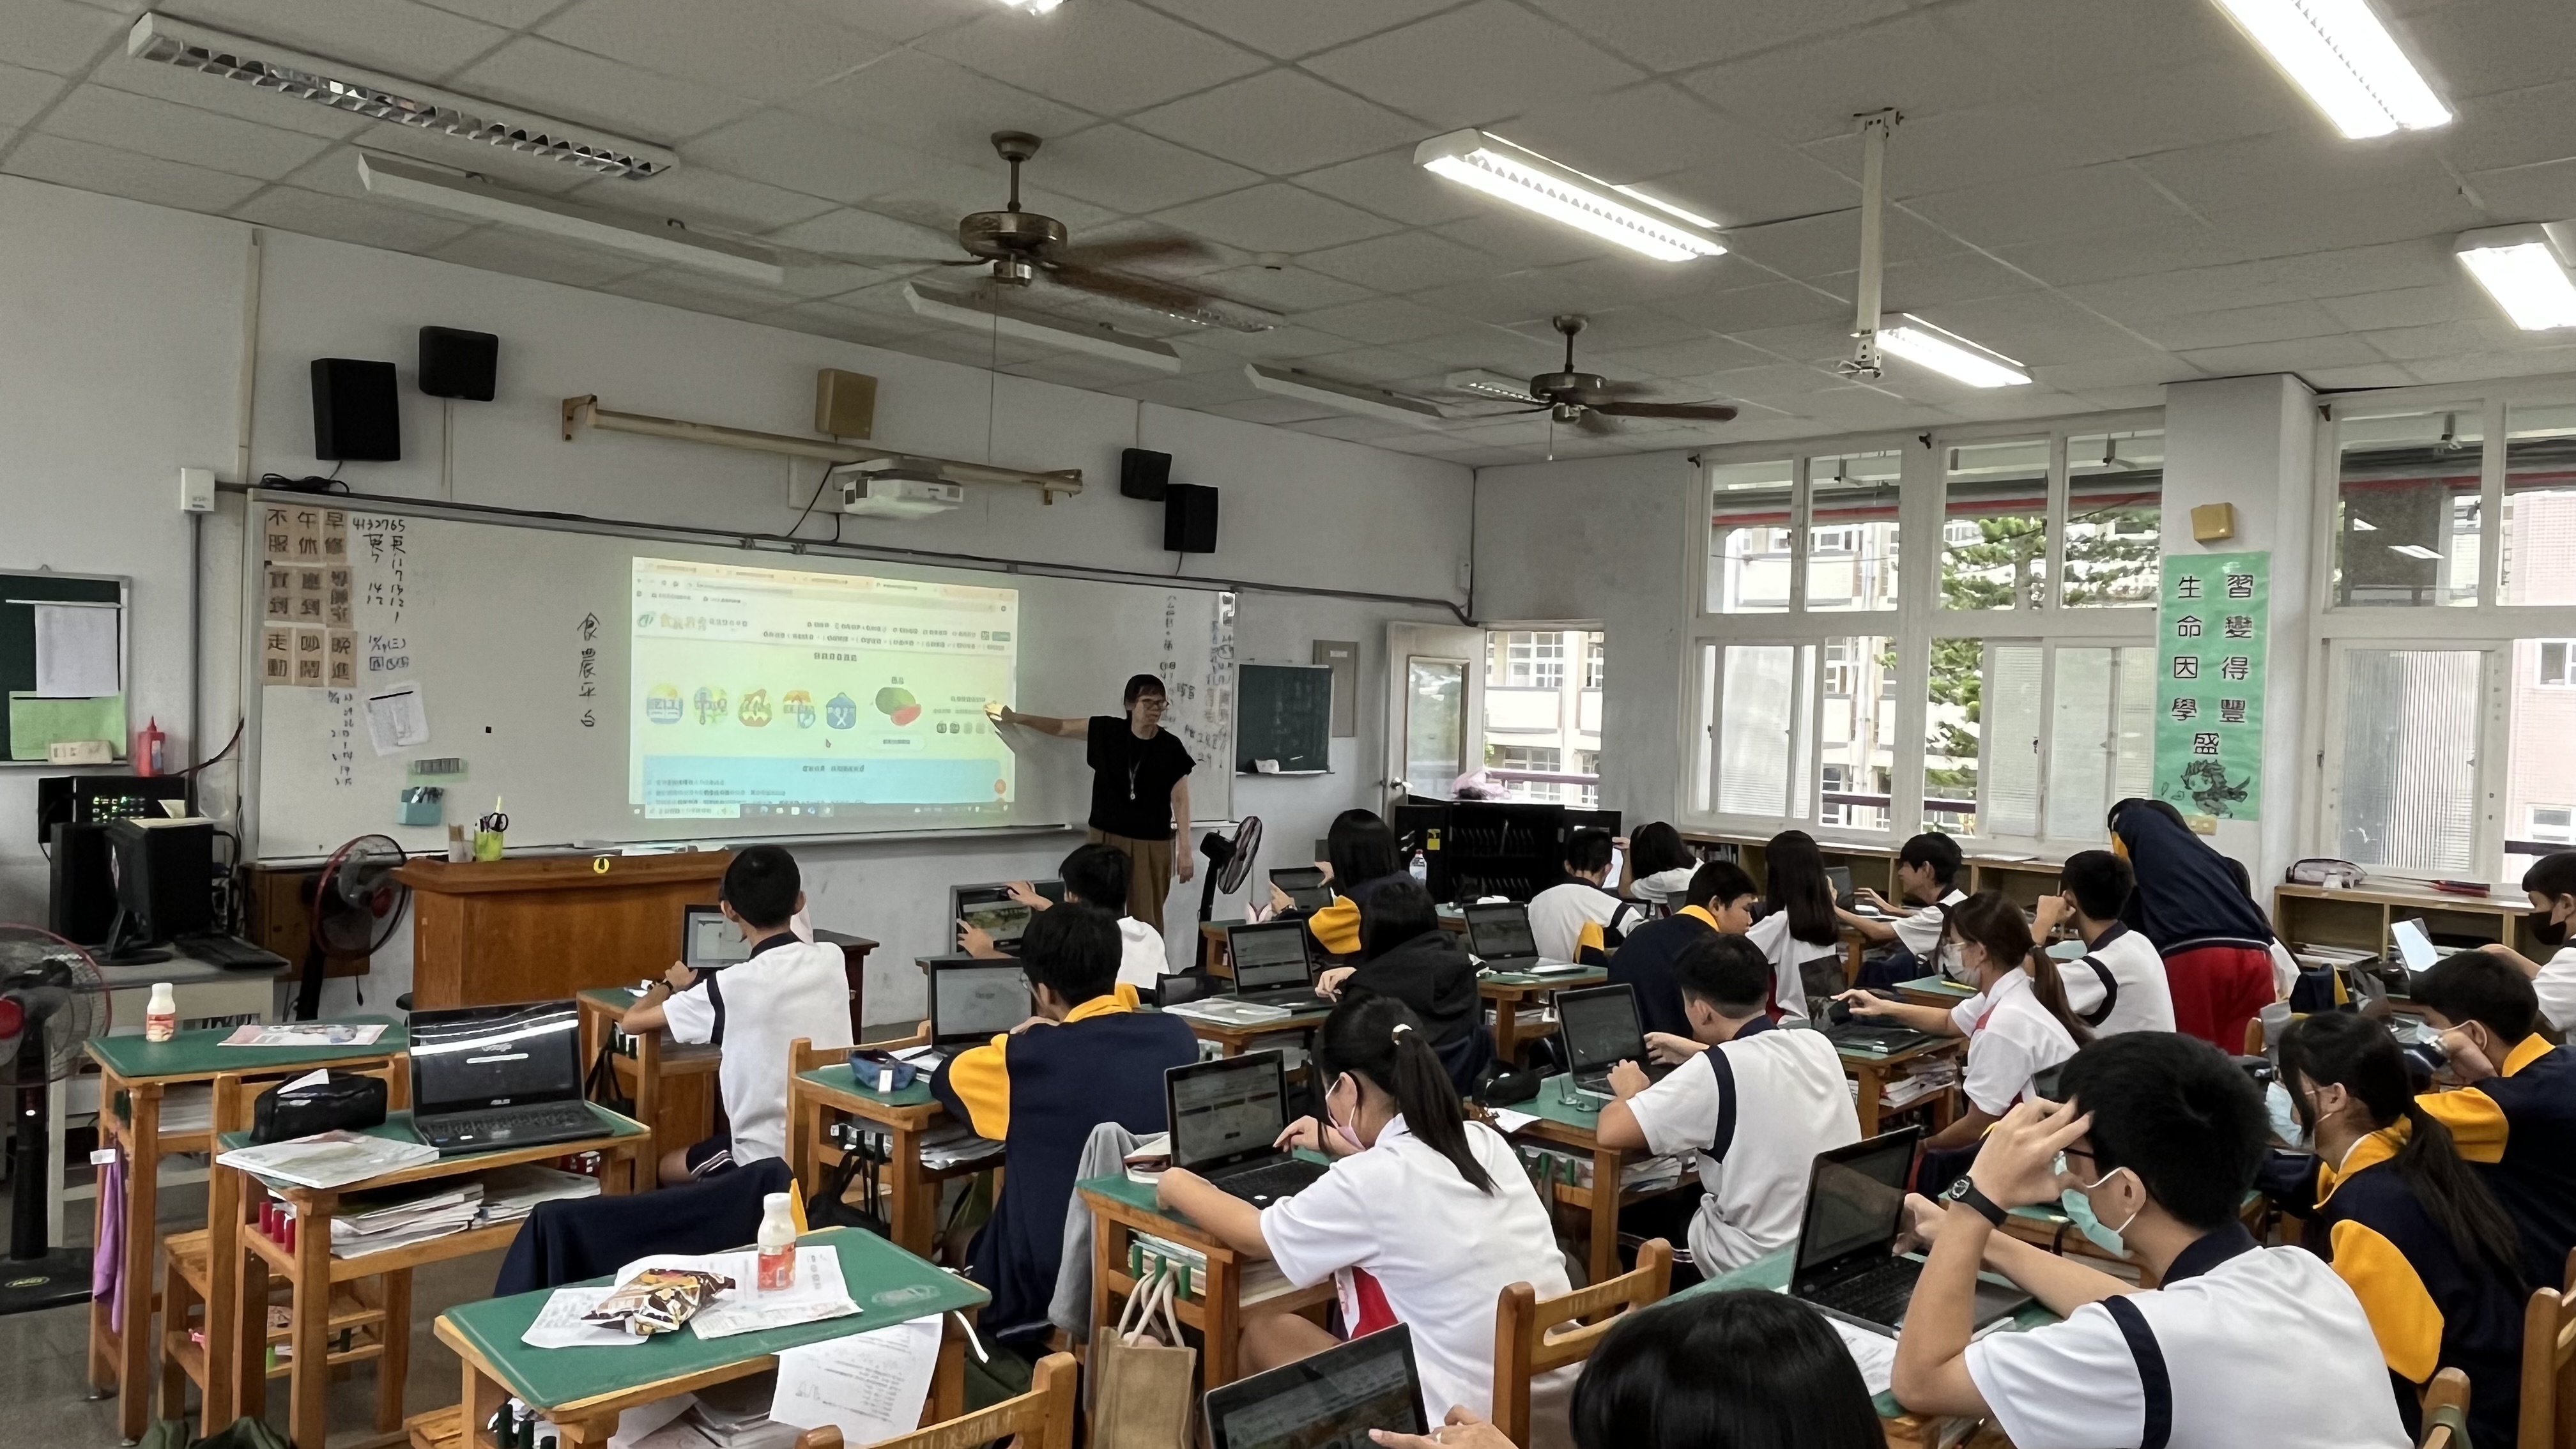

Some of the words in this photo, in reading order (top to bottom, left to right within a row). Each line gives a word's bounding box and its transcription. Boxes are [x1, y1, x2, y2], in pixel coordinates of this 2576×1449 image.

[576, 611, 601, 728] 食農平台
[2170, 574, 2203, 721] 生命因學
[2218, 573, 2255, 724] 習變得豐
[2193, 732, 2220, 755] 盛
